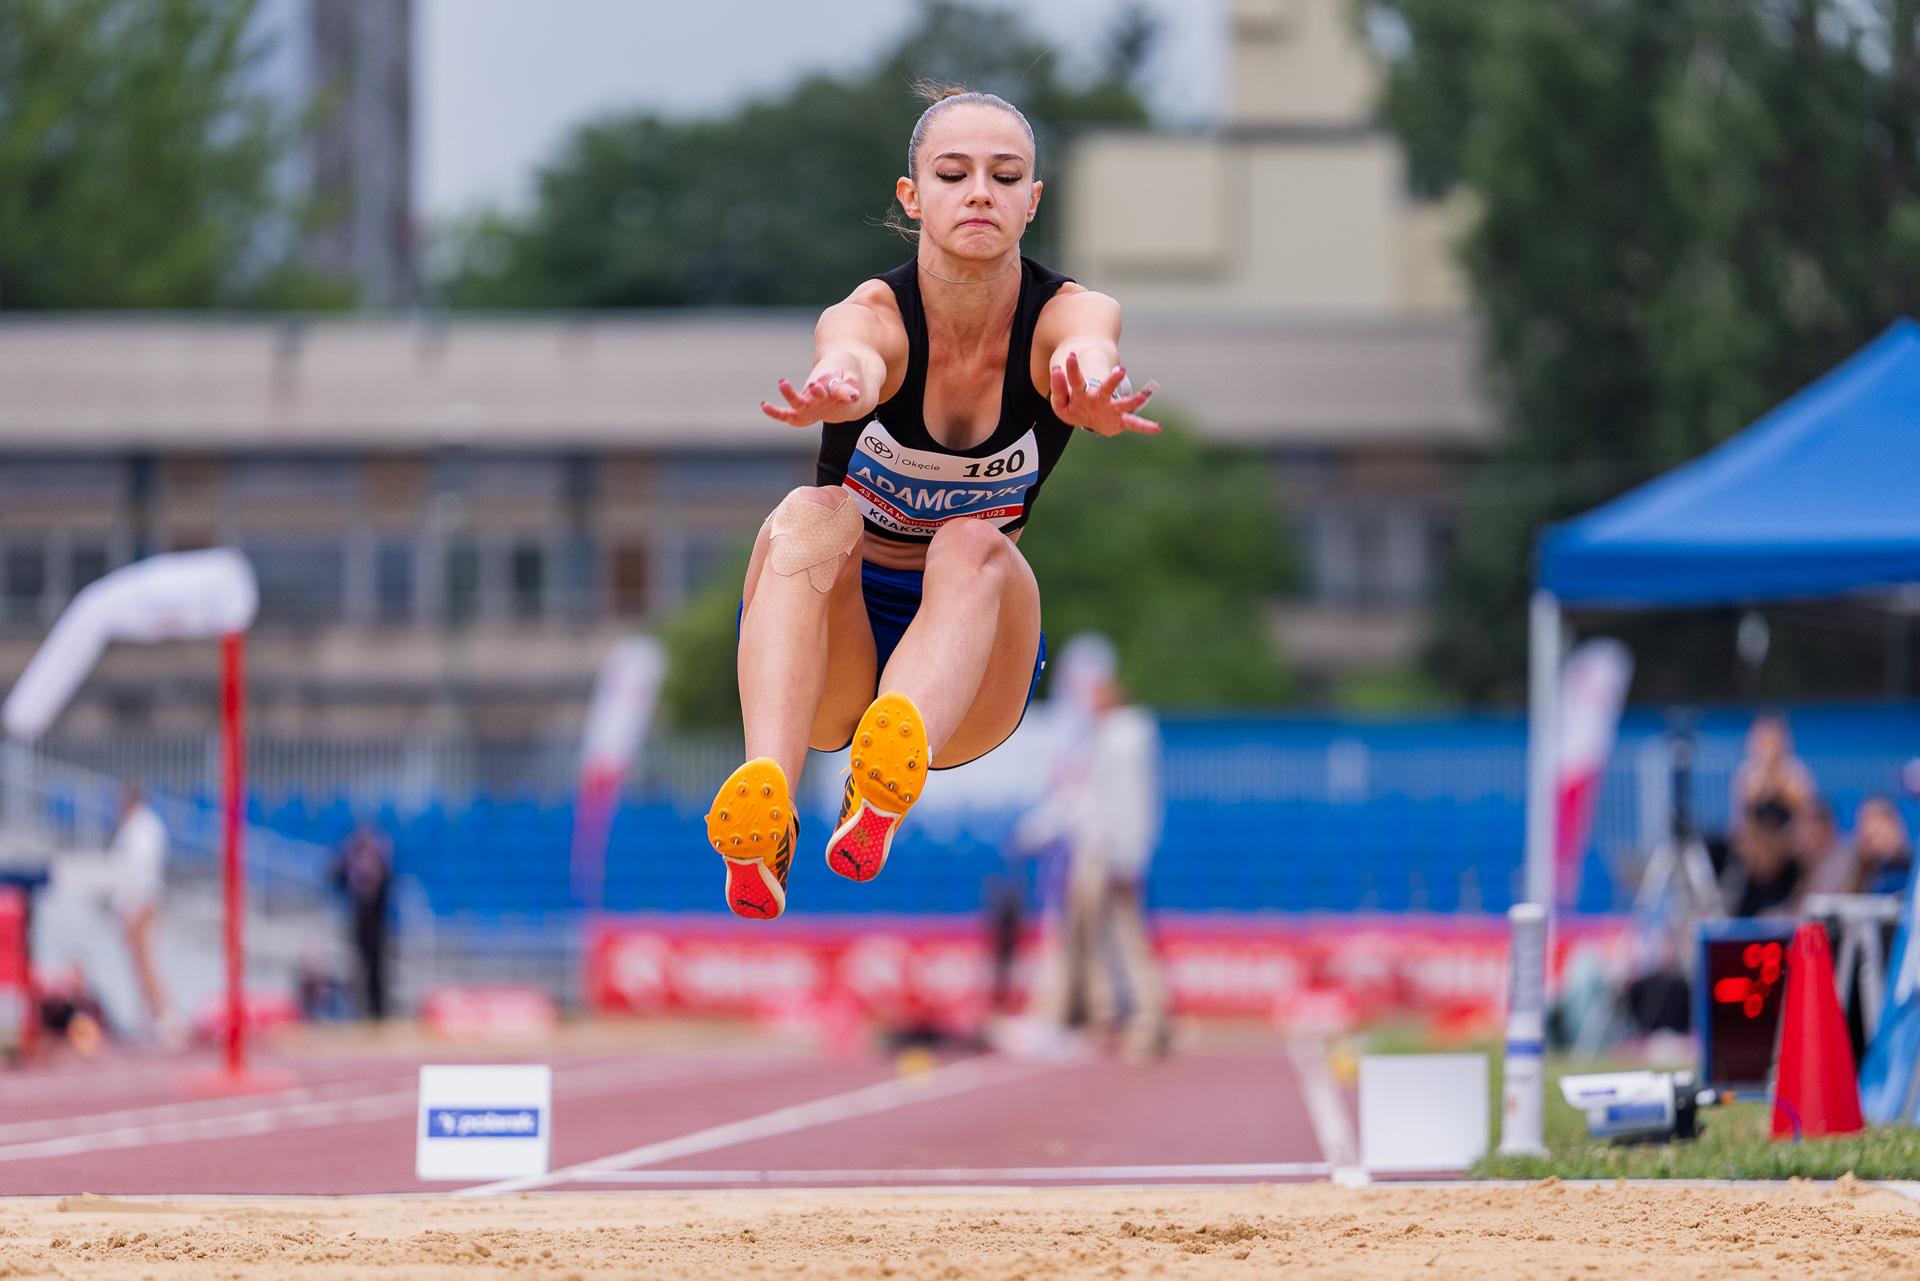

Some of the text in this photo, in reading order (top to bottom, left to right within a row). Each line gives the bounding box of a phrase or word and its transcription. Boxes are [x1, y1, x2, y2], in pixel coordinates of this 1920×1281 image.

[901, 458, 941, 472] Okęcie
[962, 449, 1025, 478] 180
[855, 466, 1029, 512] ADAMCZYK
[858, 487, 872, 500] 43.
[873, 497, 894, 515] PZLA
[986, 508, 1006, 518] U23
